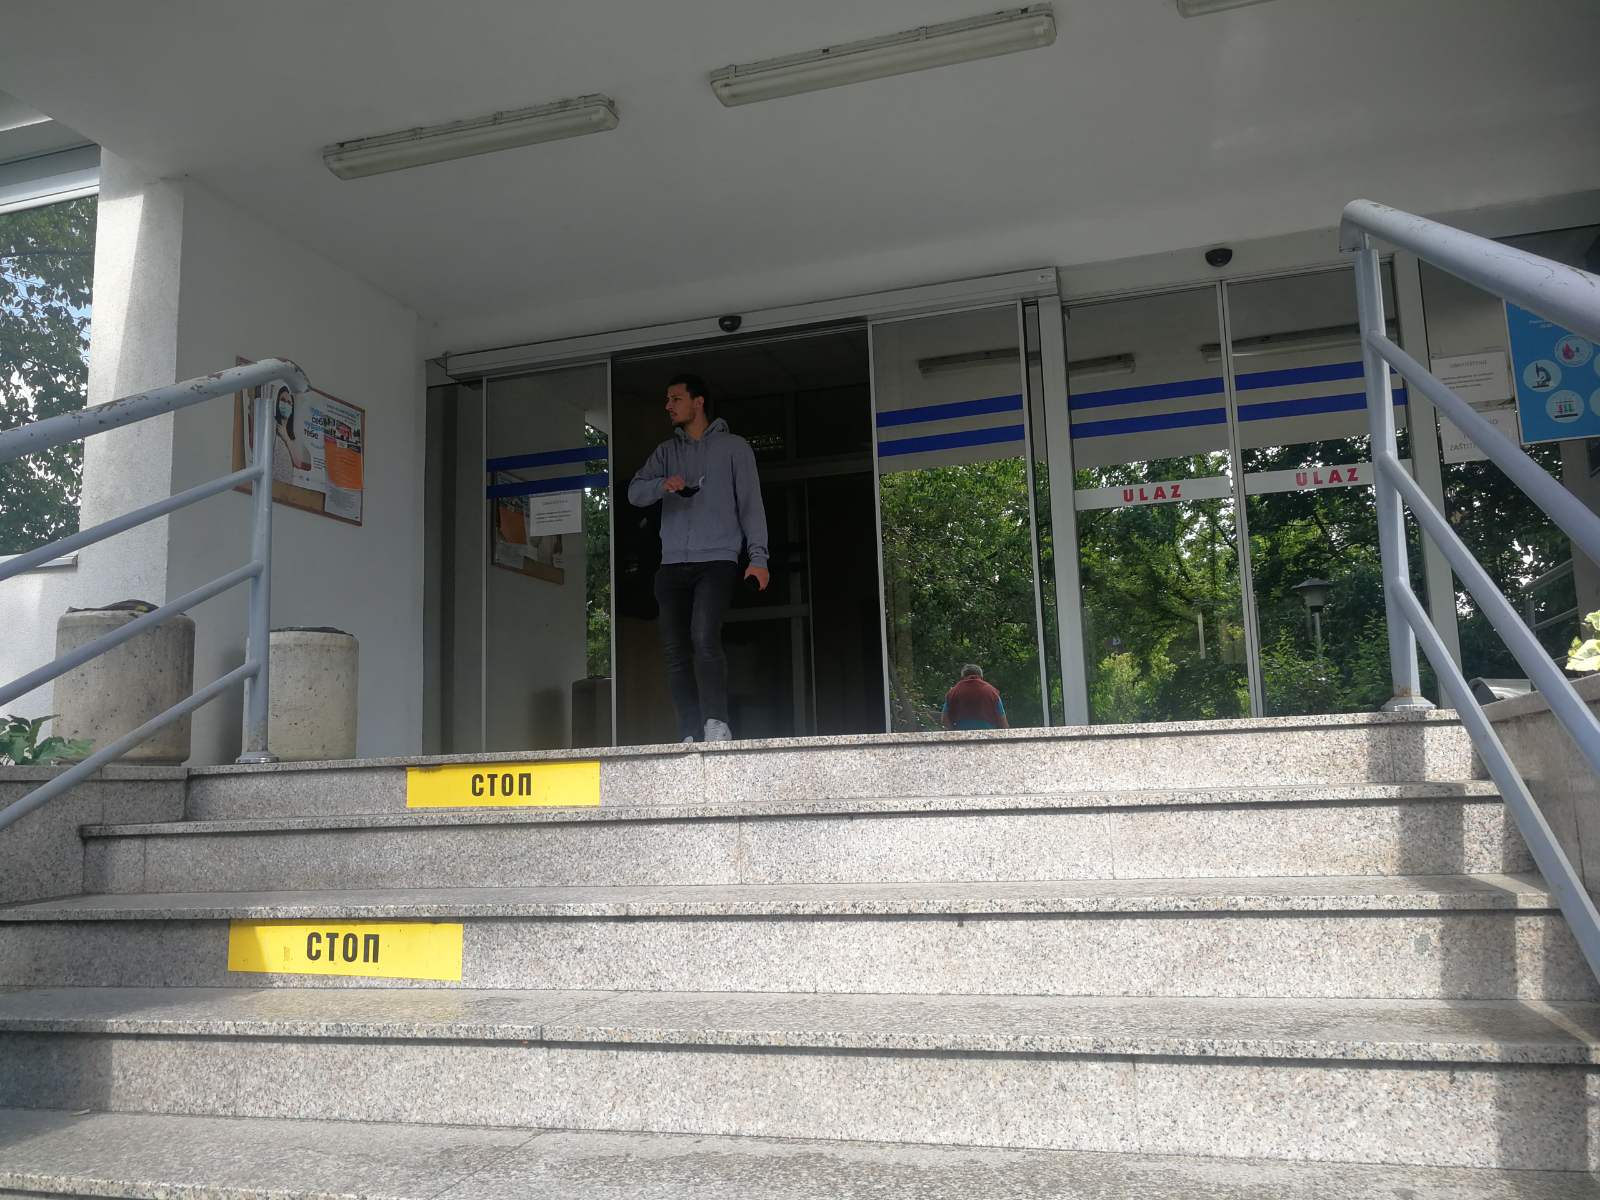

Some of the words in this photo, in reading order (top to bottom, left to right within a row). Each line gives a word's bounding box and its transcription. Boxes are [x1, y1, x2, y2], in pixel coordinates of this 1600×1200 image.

[1295, 467, 1360, 487] ULAZ
[1123, 484, 1182, 503] ULAZ
[471, 772, 533, 797] СТОП
[306, 931, 381, 964] СТОП
